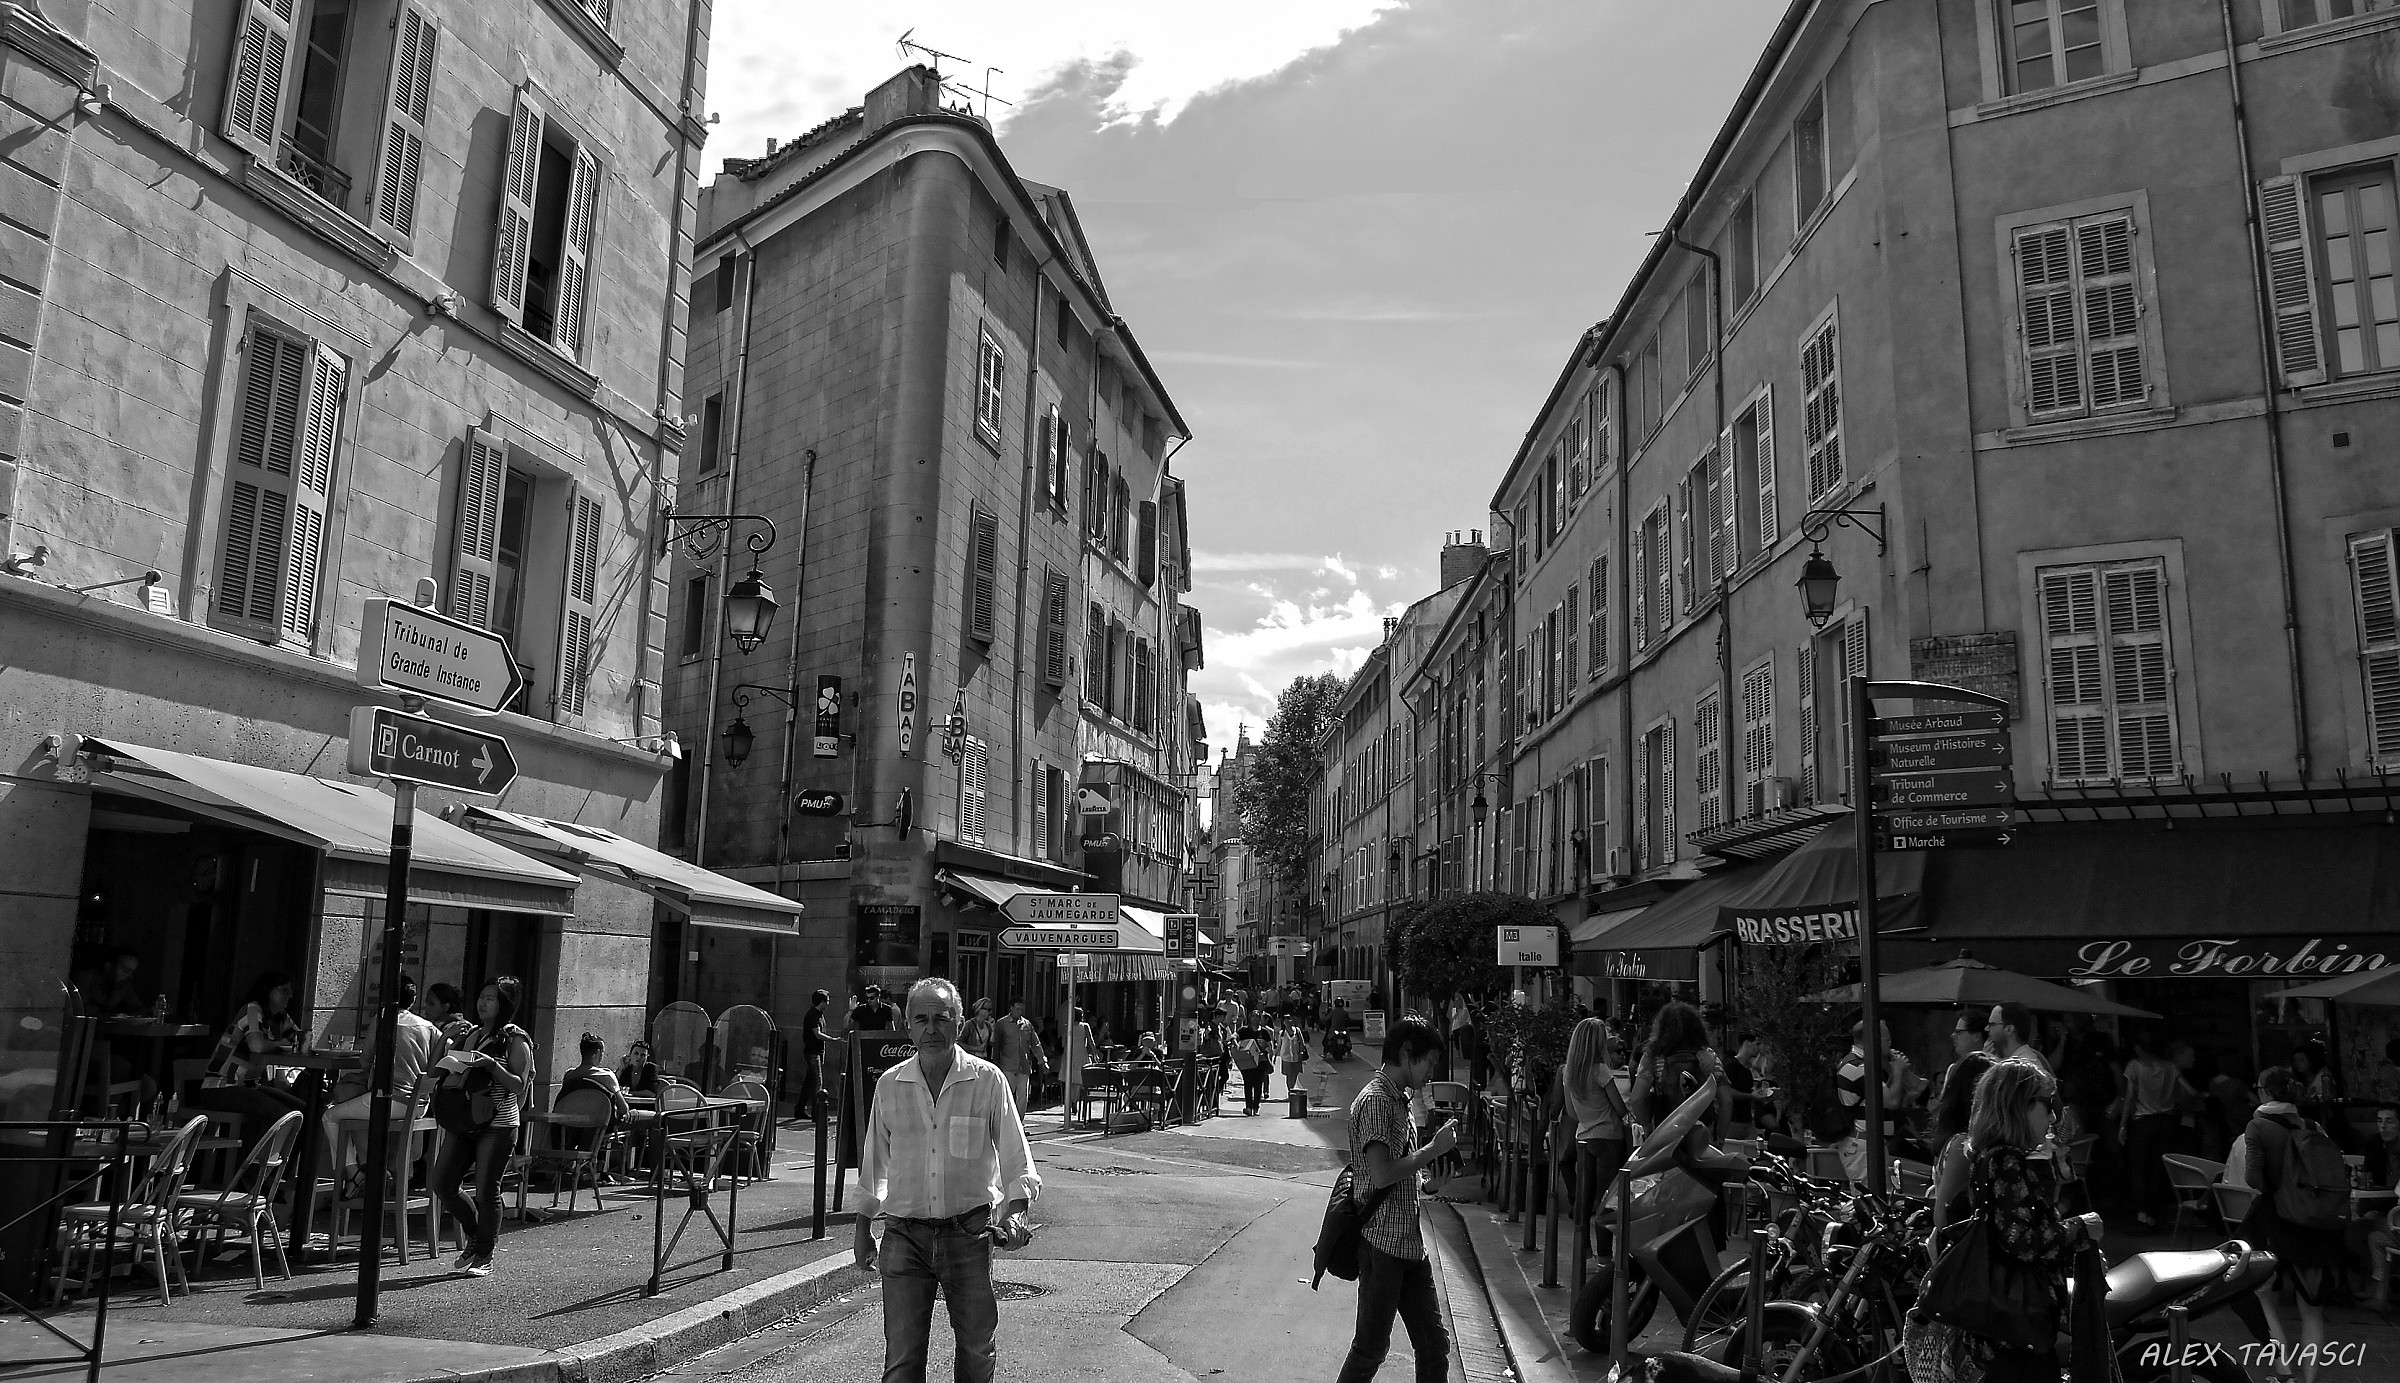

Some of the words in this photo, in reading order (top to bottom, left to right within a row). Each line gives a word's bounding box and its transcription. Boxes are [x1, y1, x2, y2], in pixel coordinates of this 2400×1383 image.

[394, 620, 449, 655] Tribunal
[453, 640, 469, 661] de
[390, 651, 431, 679] Grande
[436, 664, 481, 693] Instance
[900, 657, 915, 745] TABAC
[1889, 718, 1922, 732] Musée
[1924, 715, 1963, 729] Arbaud
[401, 734, 461, 769] Carnot
[1889, 742, 1932, 755] Museum
[1933, 737, 1986, 751] d'Histoires
[1890, 755, 1936, 768] Naturelle
[1891, 777, 1935, 789] Tribunal
[800, 798, 823, 809] PMU
[1891, 792, 1905, 804] de
[1908, 791, 1968, 803] Commerce
[1893, 816, 1923, 829] Office
[1926, 815, 1938, 827] de
[1940, 813, 1987, 826] Tourisme
[1083, 839, 1103, 848] PMU
[1908, 835, 1946, 848] Marché
[1047, 899, 1081, 908] MARC
[1029, 909, 1115, 920] JAUMEGARDE
[1736, 909, 1861, 943] BRASSERI
[1015, 932, 1115, 944] VAUVENARGUES
[1505, 931, 1518, 940] M3
[1518, 951, 1543, 962] Italie
[2068, 940, 2152, 976] Le
[2168, 938, 2391, 976] Forbin
[1616, 951, 1646, 978] Forbin
